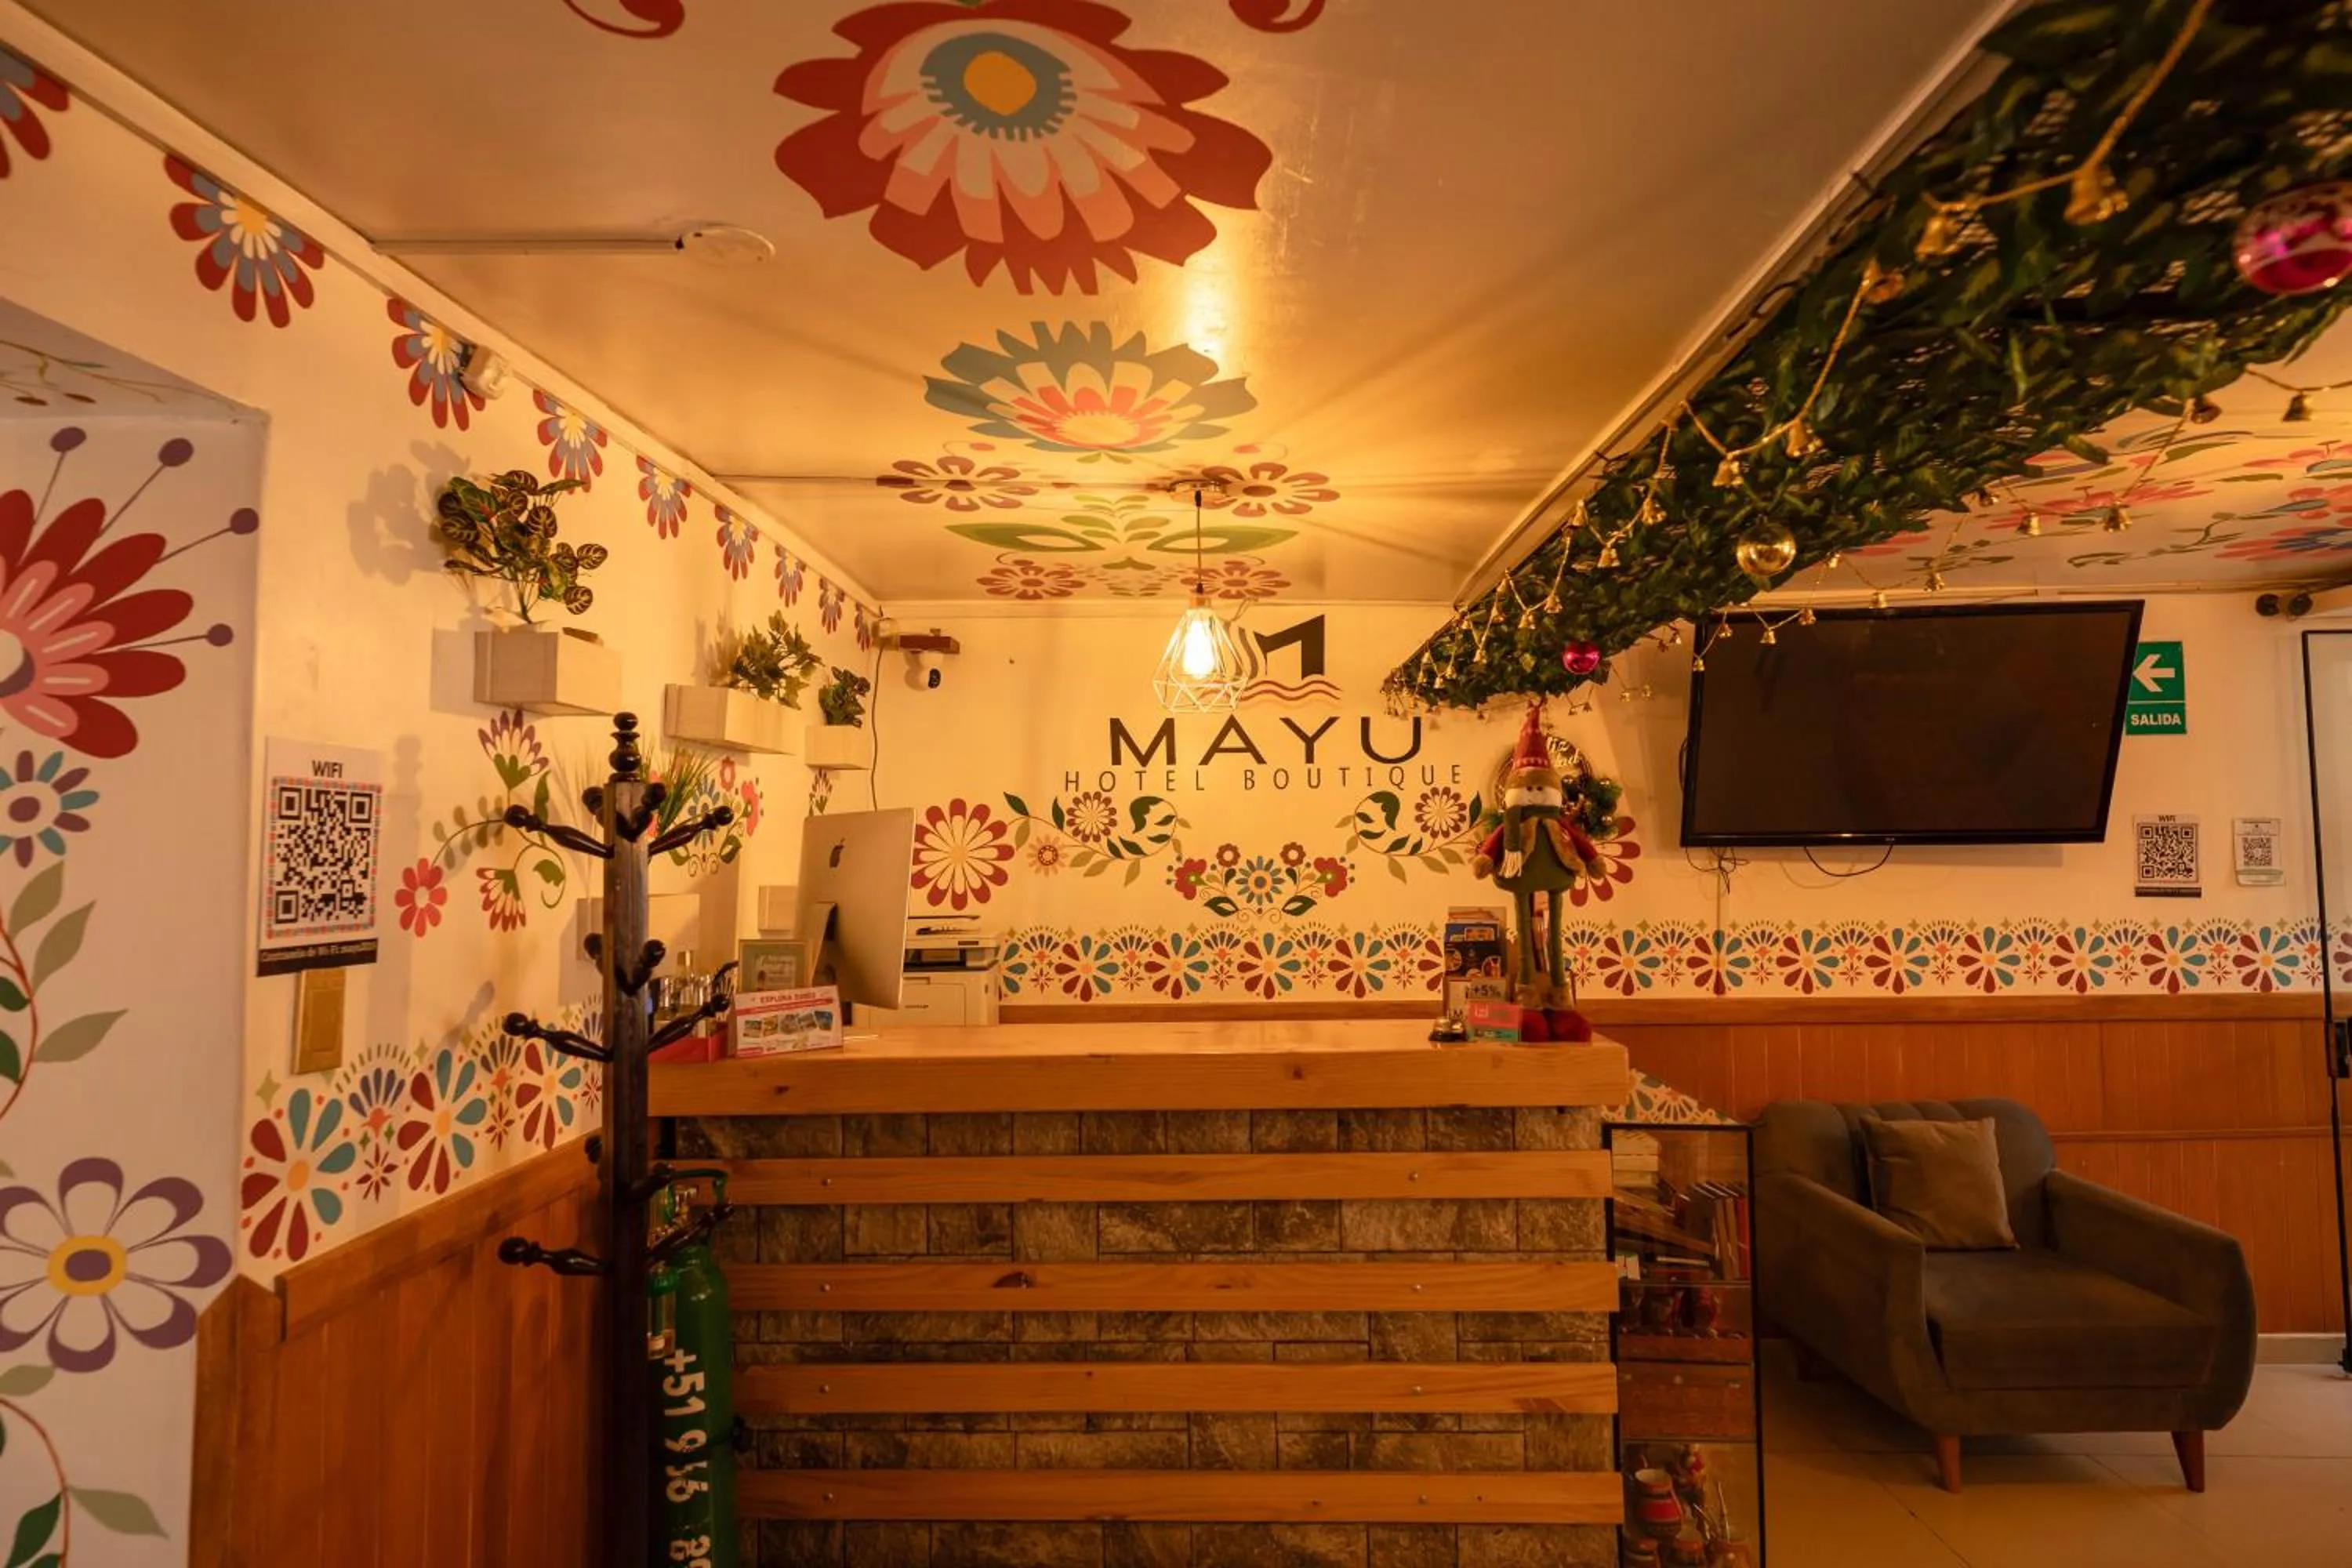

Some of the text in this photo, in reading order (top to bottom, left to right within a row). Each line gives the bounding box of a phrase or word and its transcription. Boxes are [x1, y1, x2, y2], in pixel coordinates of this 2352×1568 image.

[2130, 714, 2182, 726] SALIDA
[1109, 714, 1422, 767] MAYU
[312, 760, 343, 778] WIFI
[1065, 764, 1461, 792] HOTEL BOUTIQUE
[663, 1348, 706, 1417] +51
